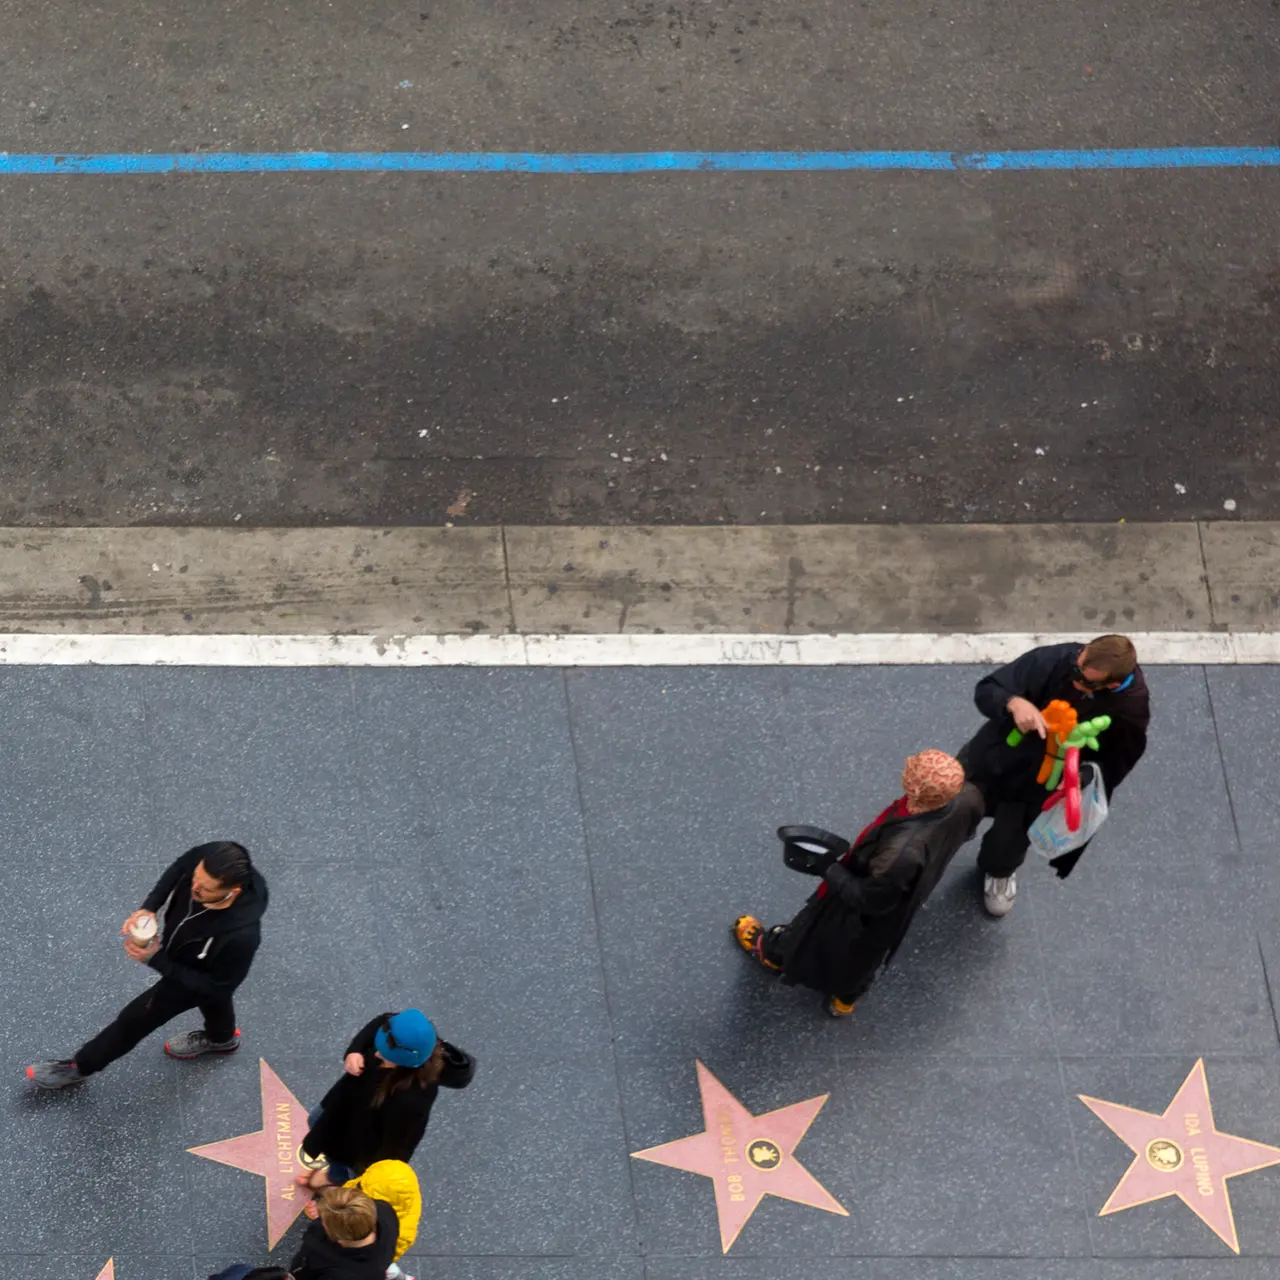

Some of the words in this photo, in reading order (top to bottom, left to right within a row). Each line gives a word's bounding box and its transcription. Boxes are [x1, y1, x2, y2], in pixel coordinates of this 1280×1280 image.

[275, 1103, 293, 1173] LICHTMAN
[1183, 1113, 1202, 1137] IDA
[1189, 1147, 1214, 1197] LUPINO
[280, 1184, 295, 1201] AL
[727, 1175, 745, 1202] BOB
